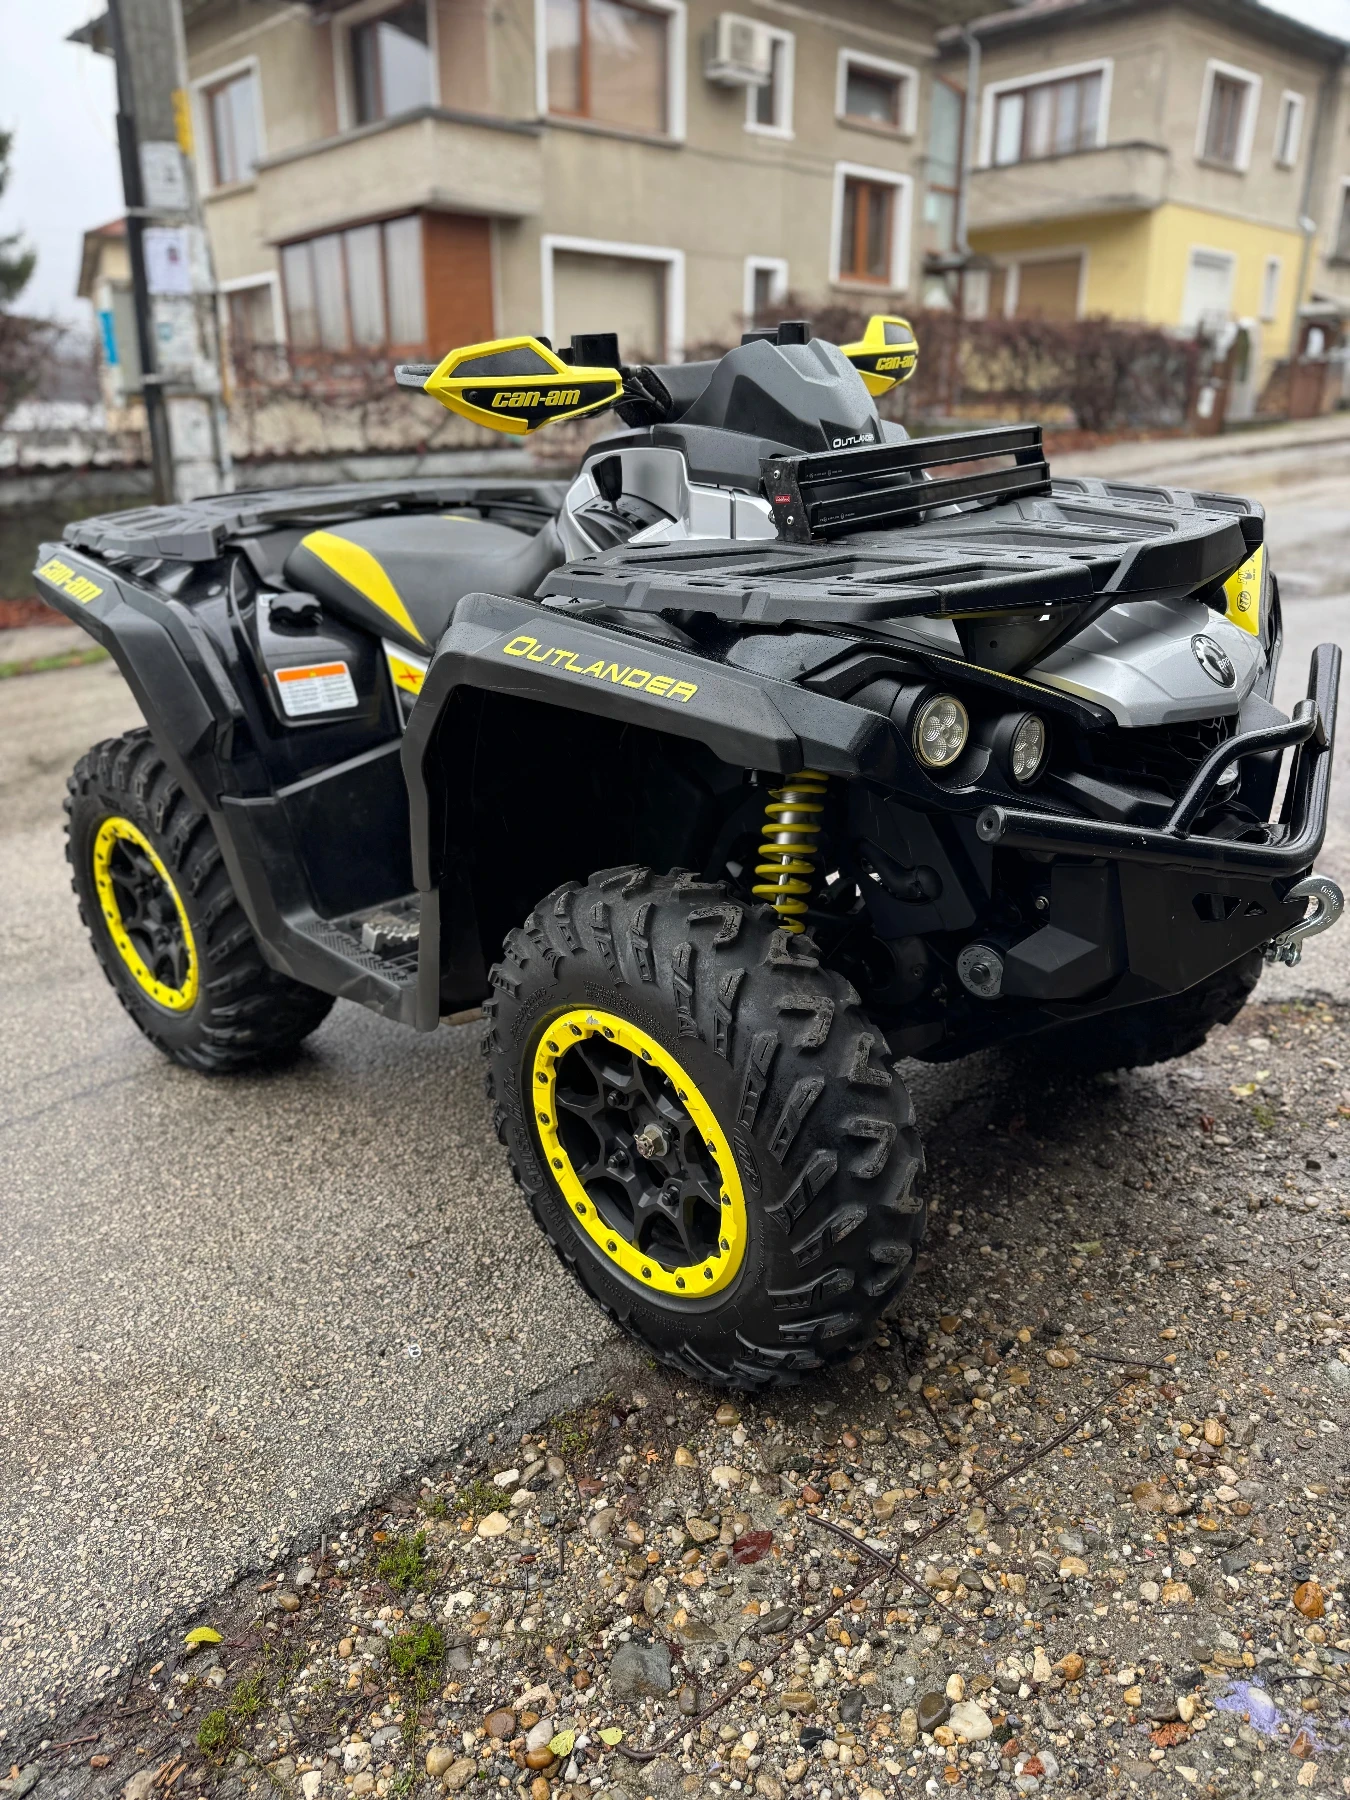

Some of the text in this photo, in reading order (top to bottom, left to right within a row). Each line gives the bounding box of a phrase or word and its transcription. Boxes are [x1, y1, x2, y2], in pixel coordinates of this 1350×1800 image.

[491, 389, 581, 408] can-am
[38, 559, 104, 605] can-am
[503, 635, 699, 703] OUTLANDER
